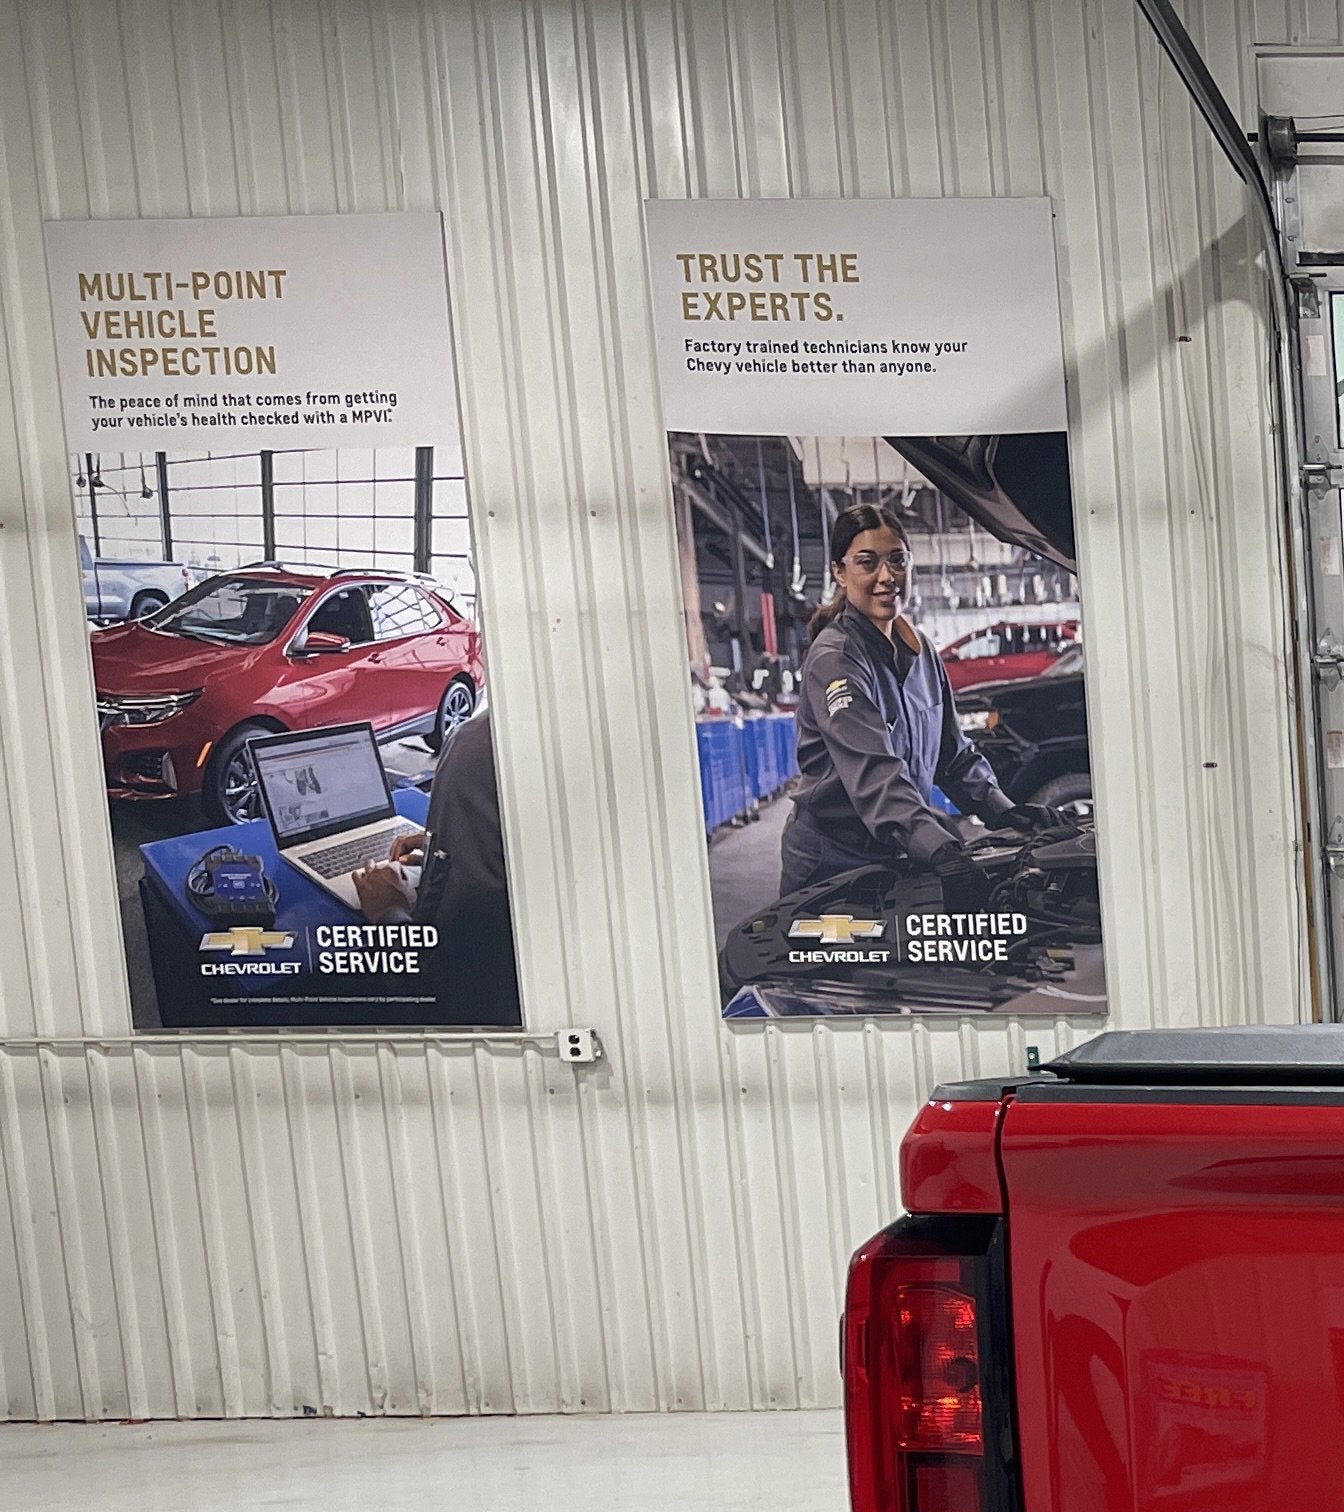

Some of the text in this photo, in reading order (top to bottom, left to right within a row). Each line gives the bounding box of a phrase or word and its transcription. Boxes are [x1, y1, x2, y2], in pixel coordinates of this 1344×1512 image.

[676, 253, 860, 284] TRUST THE
[78, 270, 287, 302] MULTI-POINT
[682, 291, 844, 321] EXPERTS.
[81, 309, 217, 339] VEHICLE
[685, 339, 968, 356] Factory trained technicians know your
[85, 346, 277, 377] INSPECTION
[686, 358, 937, 376] Chevy vehicle better than anyone.
[89, 390, 397, 412] The peace of mind that comes from getting
[92, 415, 123, 431] your
[127, 413, 188, 427] vehicle's
[192, 412, 237, 426] health
[241, 411, 299, 425] checked
[303, 410, 335, 424] with
[340, 414, 348, 423] a
[906, 913, 1027, 936] CERTIFIED
[315, 925, 438, 948] CERTIFIED
[788, 950, 890, 963] CHEVROLET
[908, 939, 1008, 962] SERVICE
[201, 960, 302, 975] CHEVROLET
[319, 952, 419, 974] SERVICE
